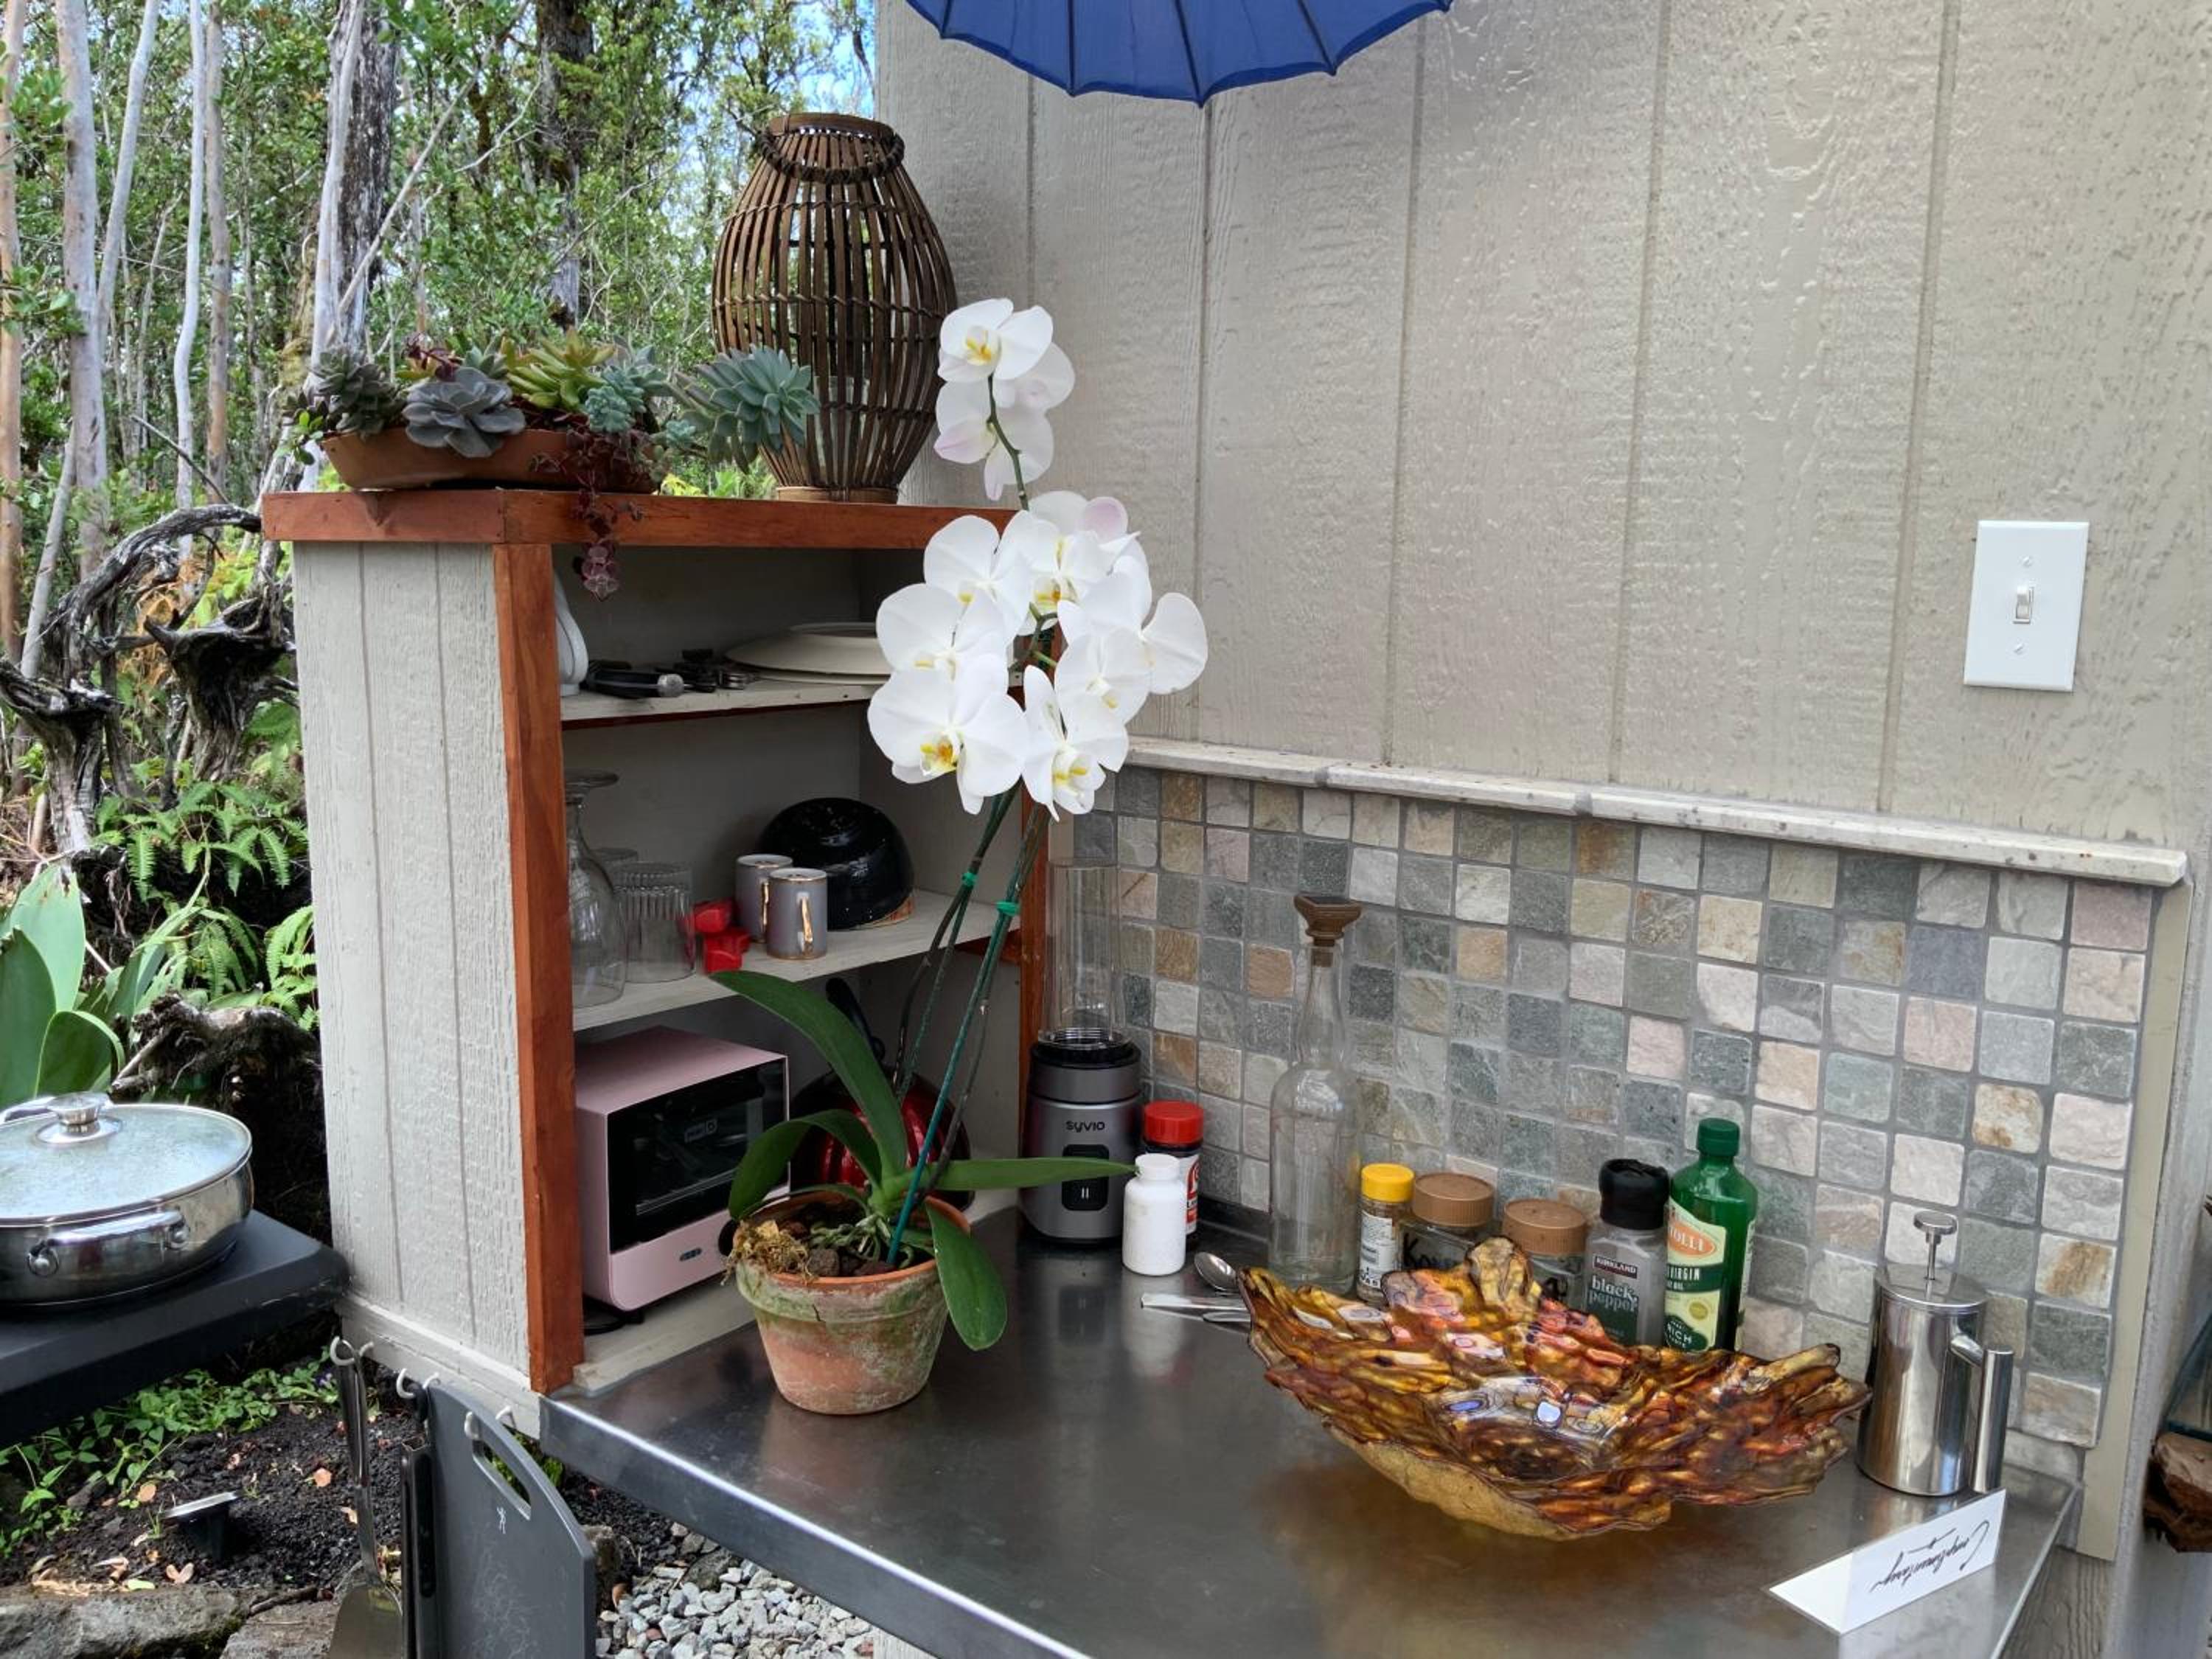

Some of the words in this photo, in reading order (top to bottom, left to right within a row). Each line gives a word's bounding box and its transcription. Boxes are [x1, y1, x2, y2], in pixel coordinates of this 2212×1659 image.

[1596, 1257, 1636, 1273] KIRKLAND
[1593, 1274, 1635, 1299] black
[1588, 1289, 1638, 1312] pepper
